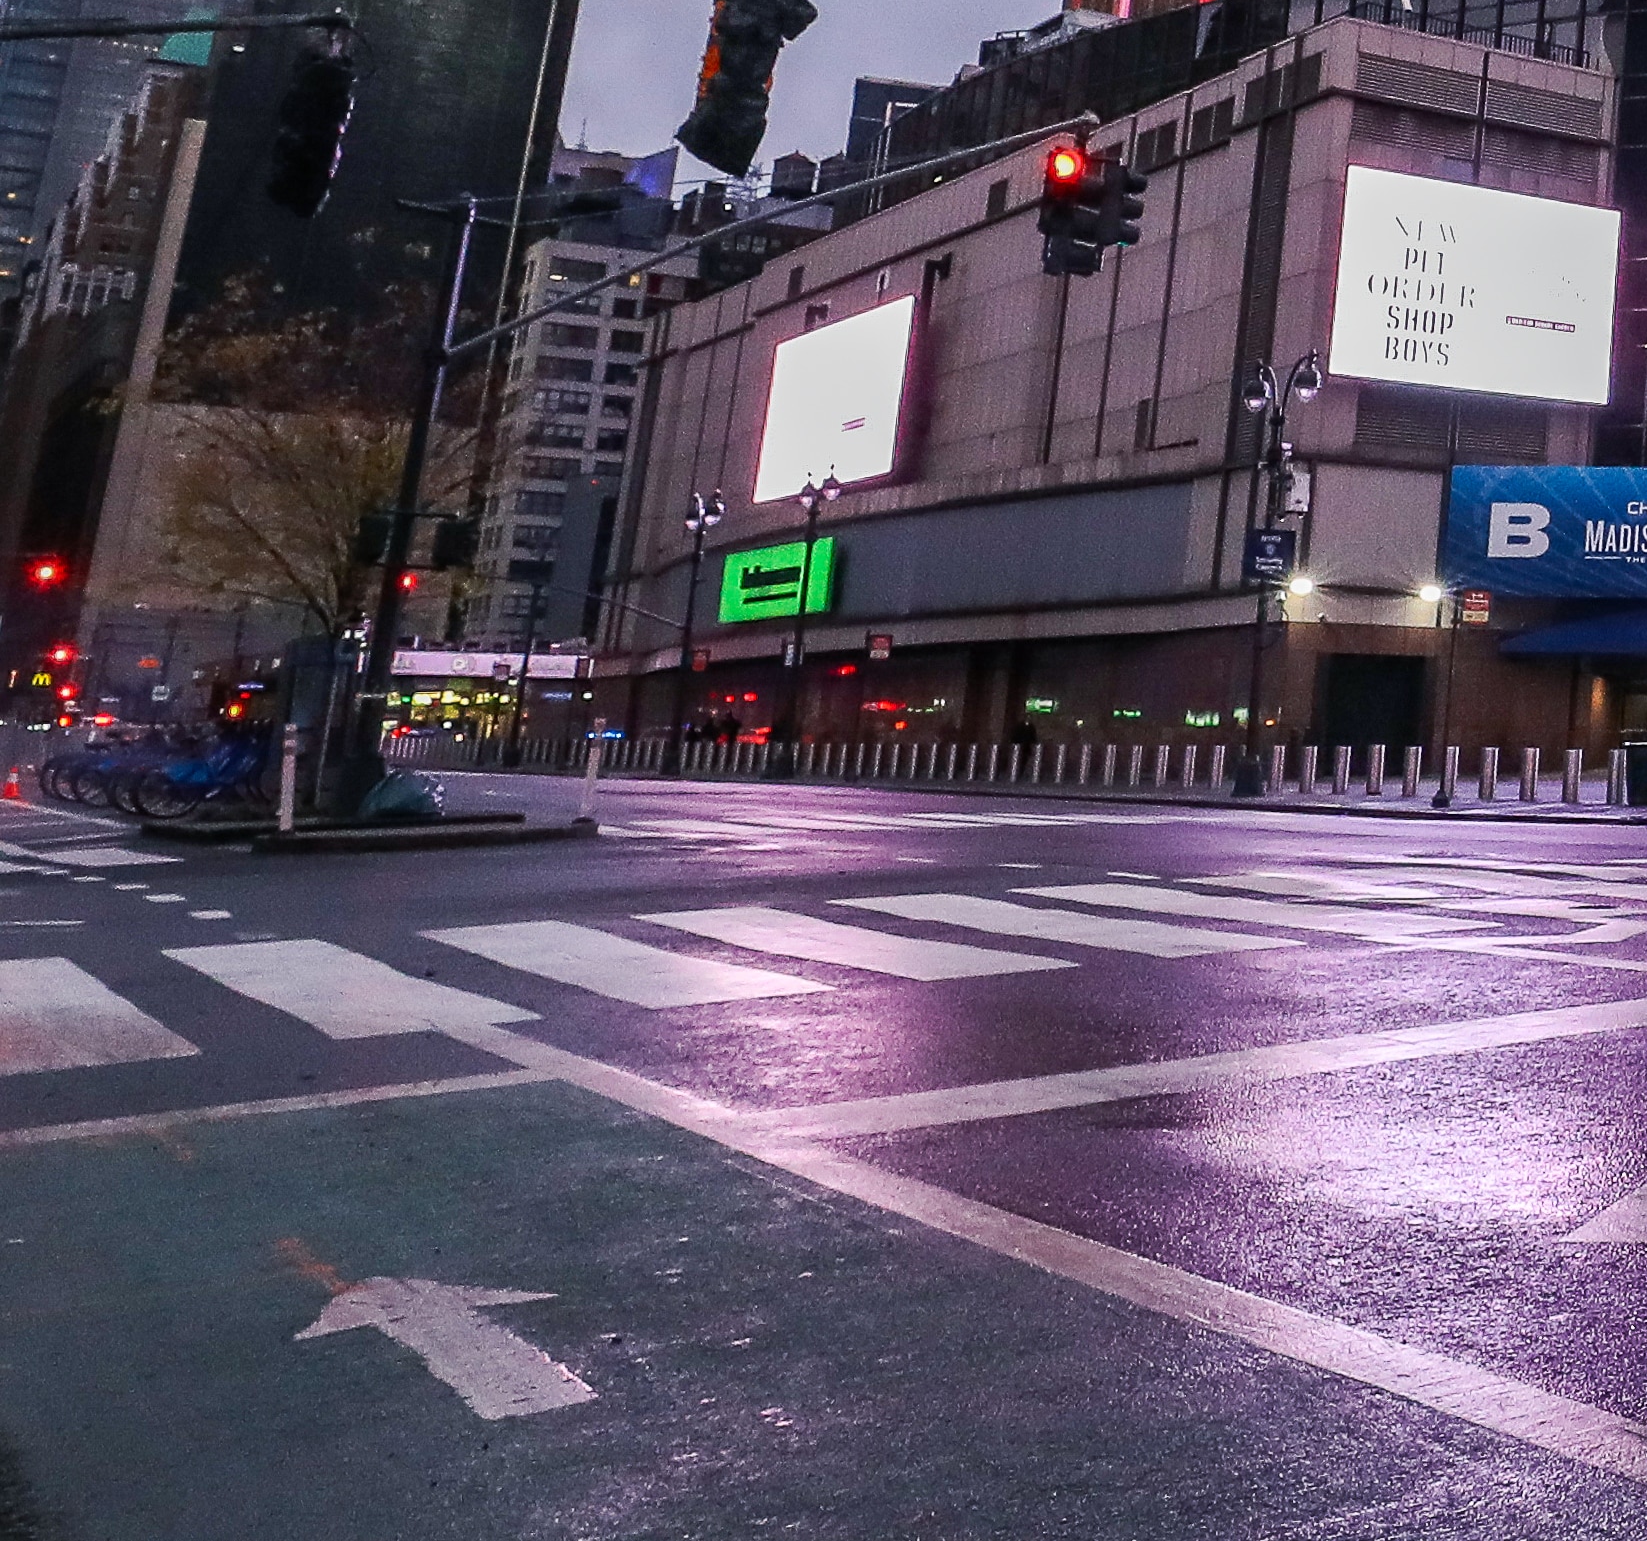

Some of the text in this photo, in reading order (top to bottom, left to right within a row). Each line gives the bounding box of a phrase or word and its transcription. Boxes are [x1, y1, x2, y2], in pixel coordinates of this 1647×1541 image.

[1386, 305, 1454, 335] SHOP
[1385, 336, 1450, 366] BOYS
[1487, 502, 1551, 558] B
